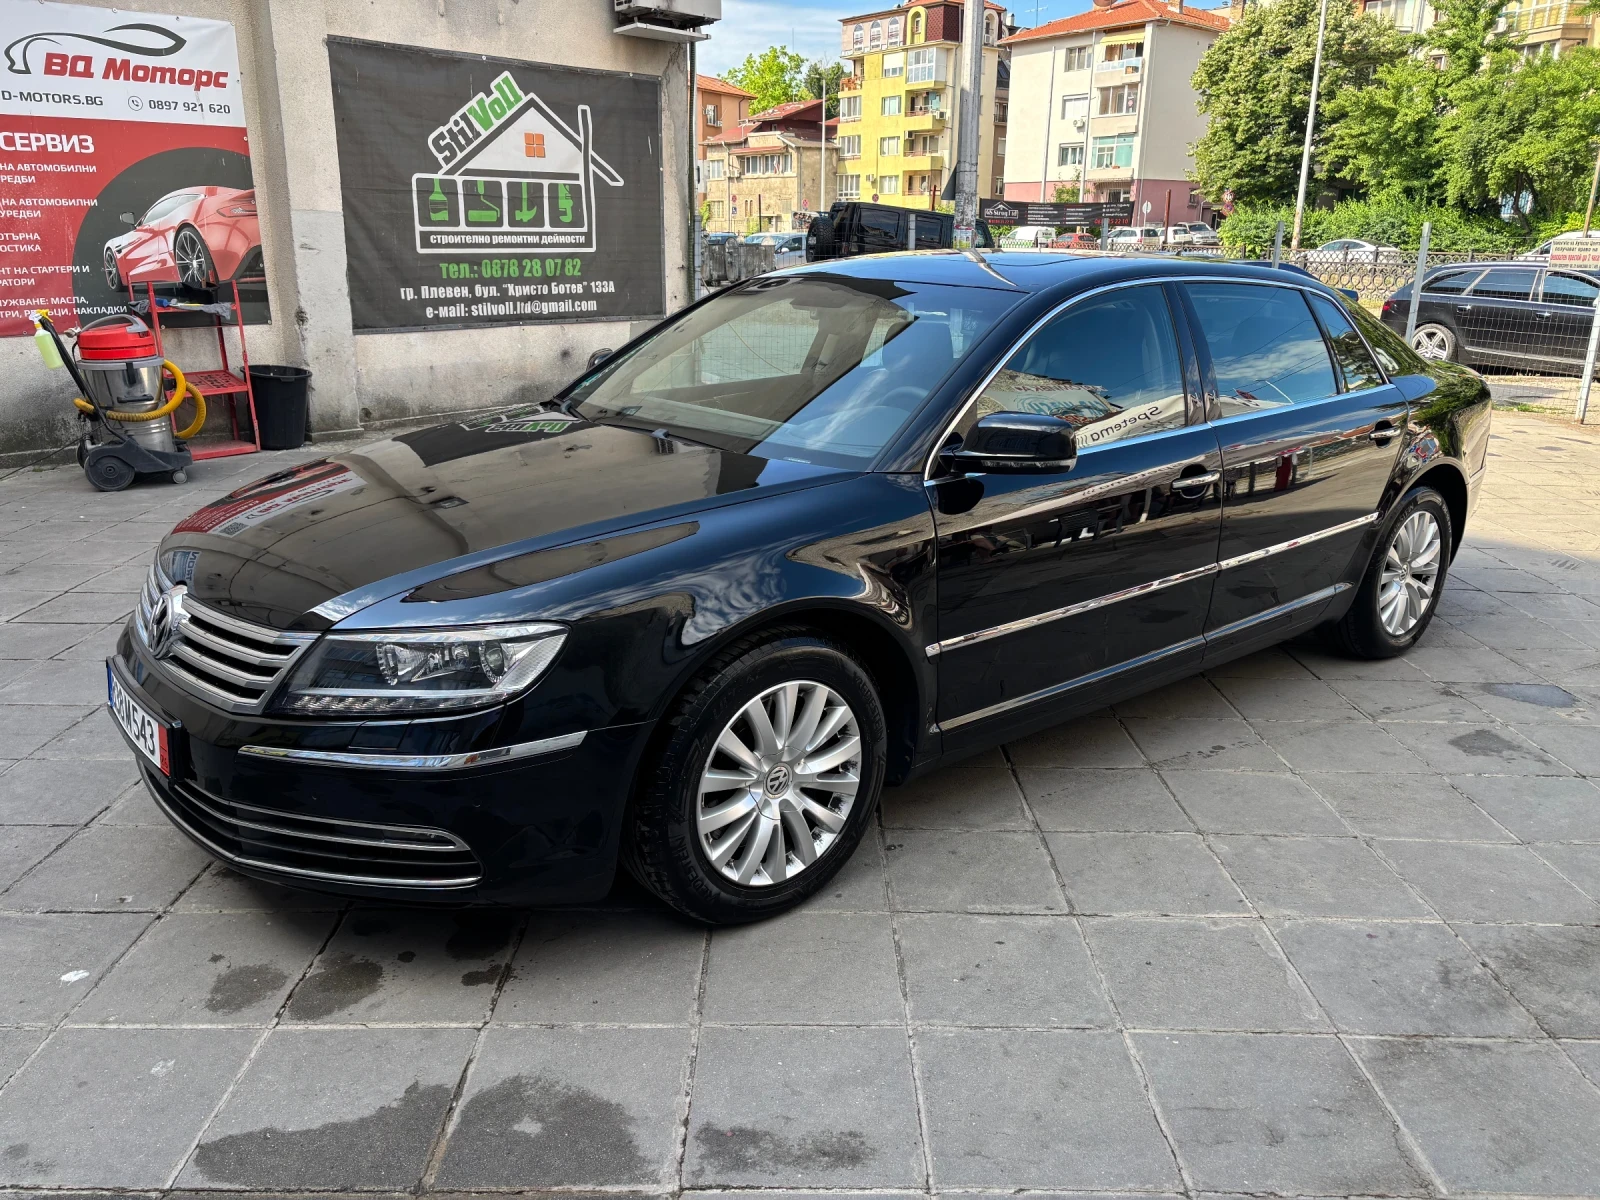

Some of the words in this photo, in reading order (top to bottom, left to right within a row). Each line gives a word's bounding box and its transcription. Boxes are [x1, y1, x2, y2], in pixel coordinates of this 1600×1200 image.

[44, 52, 94, 79] ВД
[102, 57, 229, 92] Моторс
[1, 90, 103, 106] D-MOTORS.BG
[148, 99, 179, 111] 0897
[183, 101, 204, 113] 921
[208, 103, 231, 114] 620
[430, 74, 524, 167] StilVoll
[0, 131, 95, 154] СЕРВИЗ
[17, 163, 97, 173] АВТОМОБИЛНИ
[2, 198, 17, 206] НА
[19, 198, 98, 207] АВТОМОБИЛНИ
[430, 234, 490, 245] строително
[492, 234, 539, 245] ремонтни
[541, 233, 585, 244] дейности
[31, 265, 79, 274] СТАРТЕРИ
[82, 265, 90, 273] И
[440, 262, 478, 279] тел.:
[482, 259, 519, 278] 0878
[523, 259, 542, 277] 28
[545, 258, 561, 277] 07
[564, 258, 581, 276] 82
[0, 278, 35, 286] АТОРИ
[400, 287, 417, 300] гр.
[421, 285, 472, 299] Плевен,
[475, 284, 500, 298] бул.
[51, 296, 89, 305] МАСЛА,
[74, 306, 127, 315] НАКЛАДКИ
[471, 300, 597, 317] stilvoll.ltd@gmail.com
